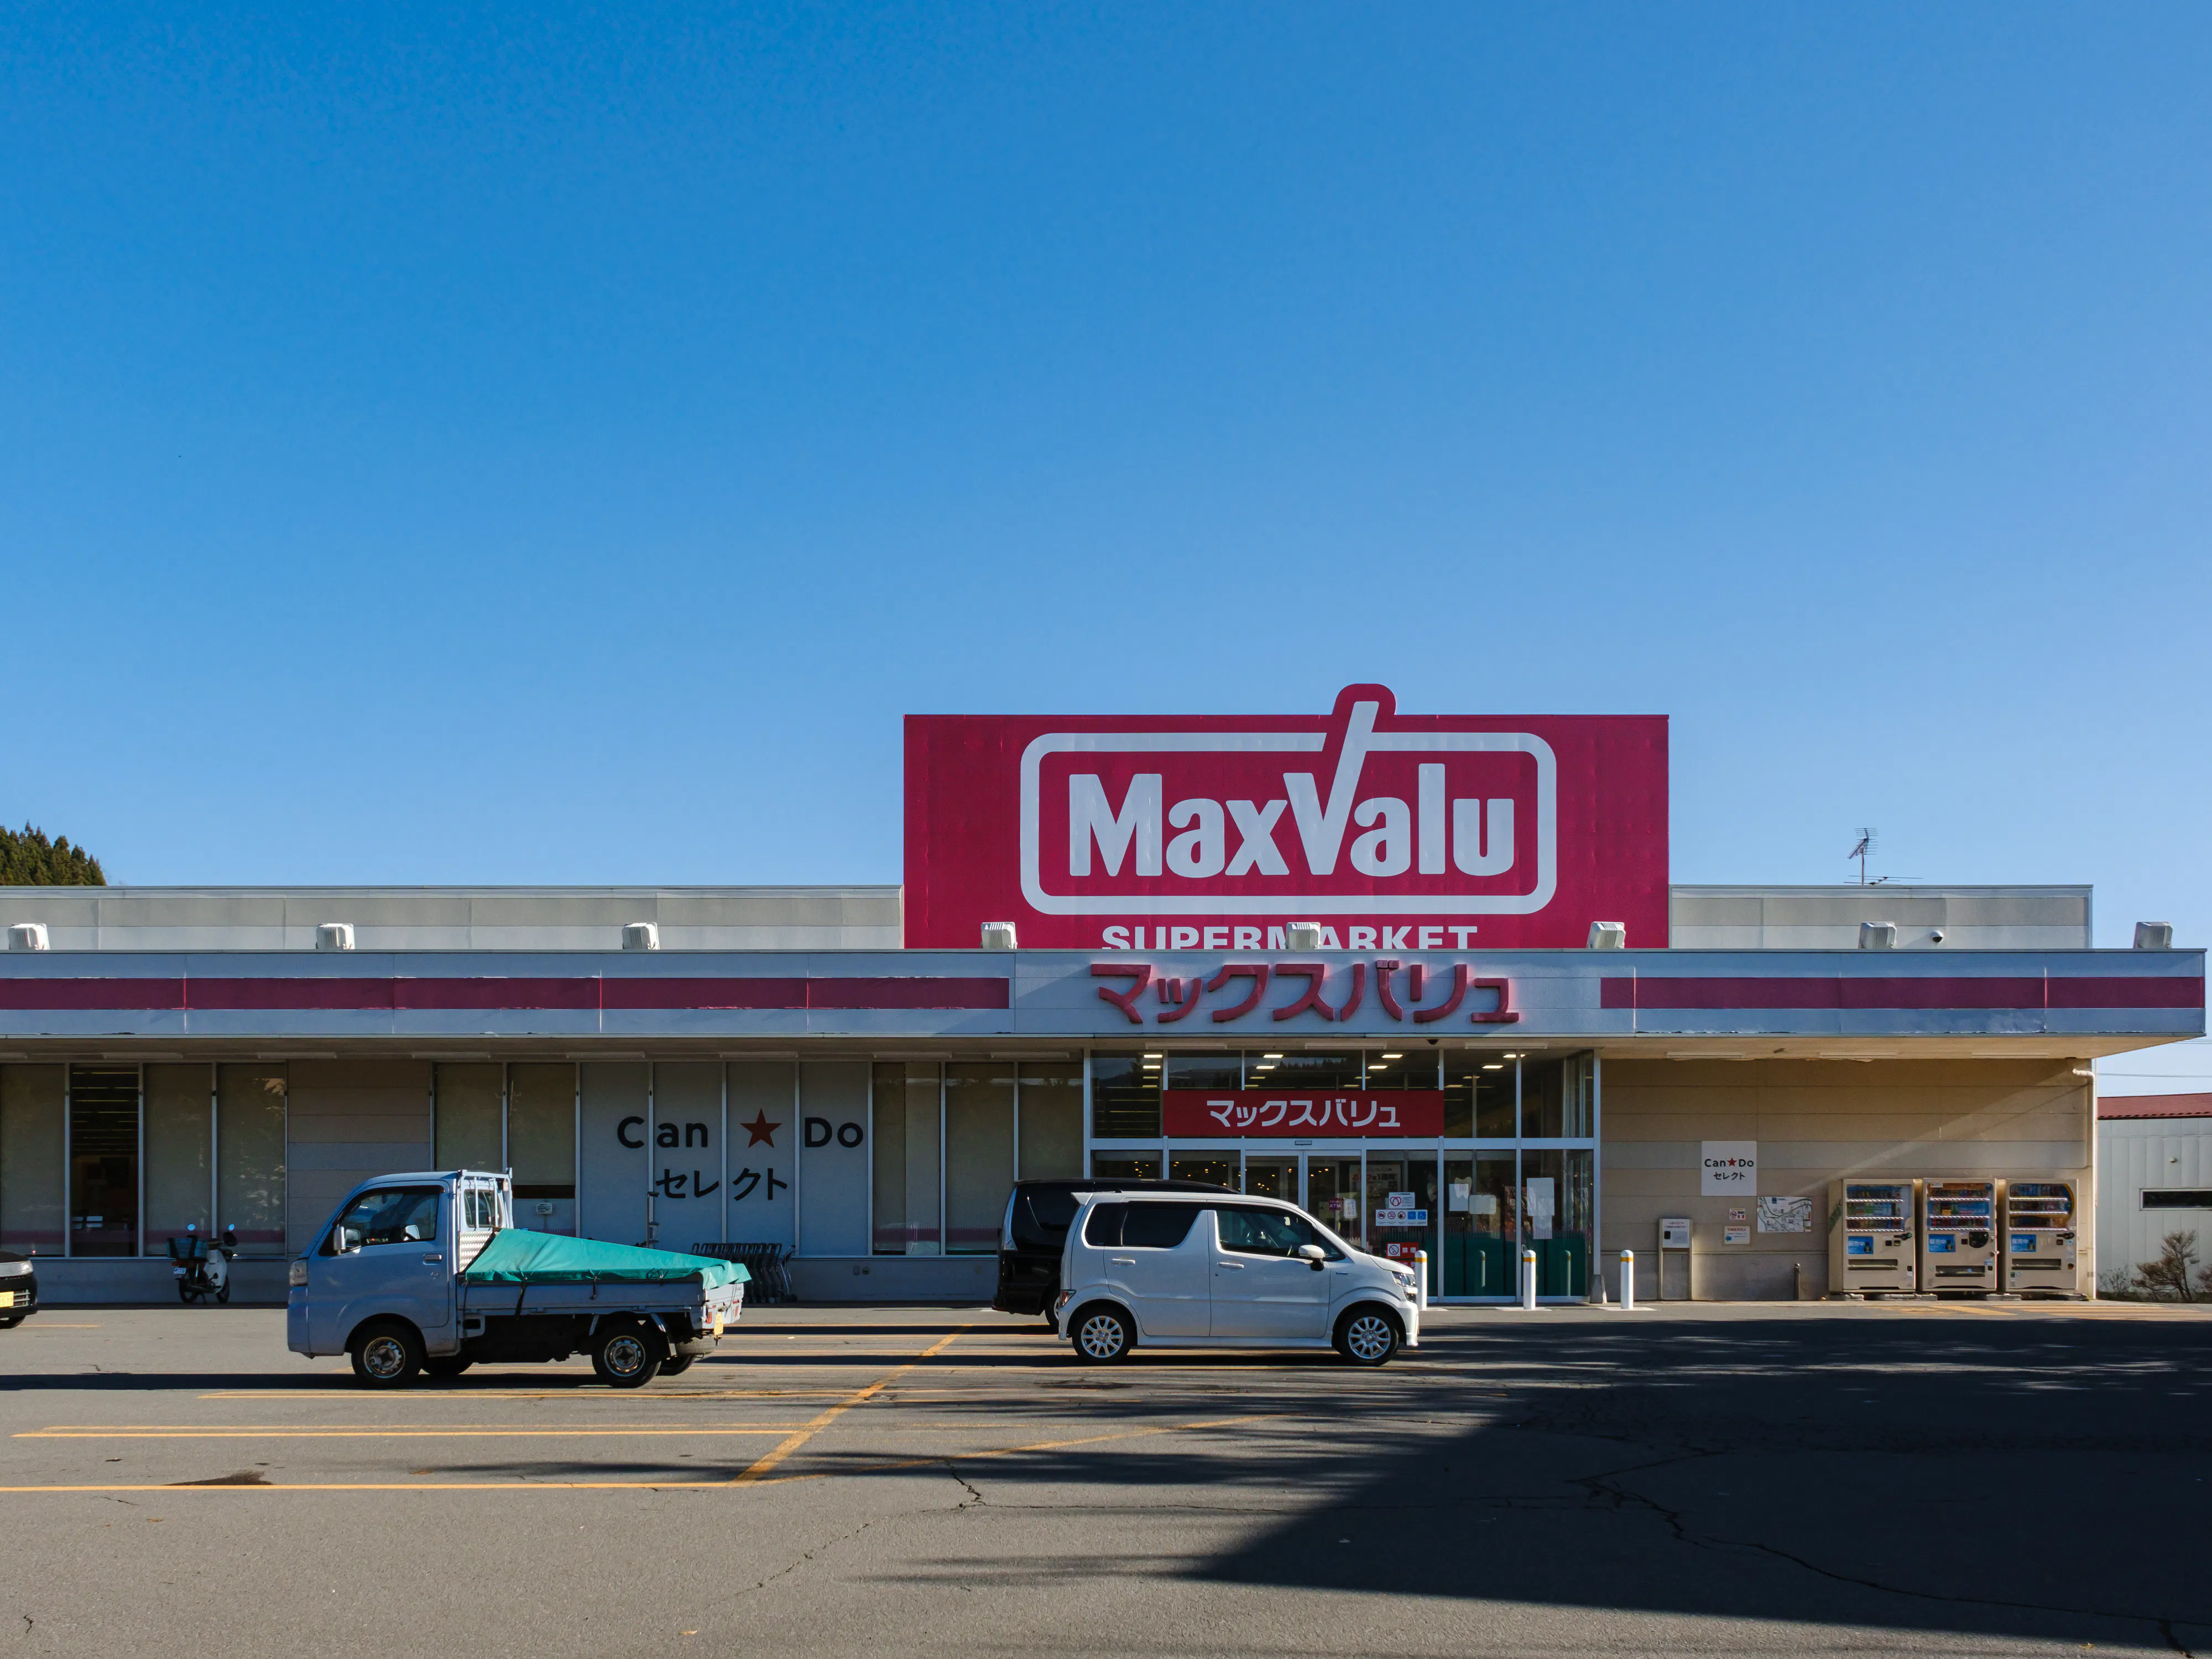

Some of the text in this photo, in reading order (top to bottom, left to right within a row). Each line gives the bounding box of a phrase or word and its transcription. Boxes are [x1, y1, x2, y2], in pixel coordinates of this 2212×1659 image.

[1068, 700, 1515, 877] MaxValu
[1090, 959, 1519, 1023] マックスバリュ
[1207, 1099, 1400, 1126] マックスバリュ
[617, 1116, 864, 1149] Can Do
[1704, 1159, 1726, 1167] Can
[1713, 1172, 1745, 1180] セレクト
[655, 1167, 788, 1201] セレクト
